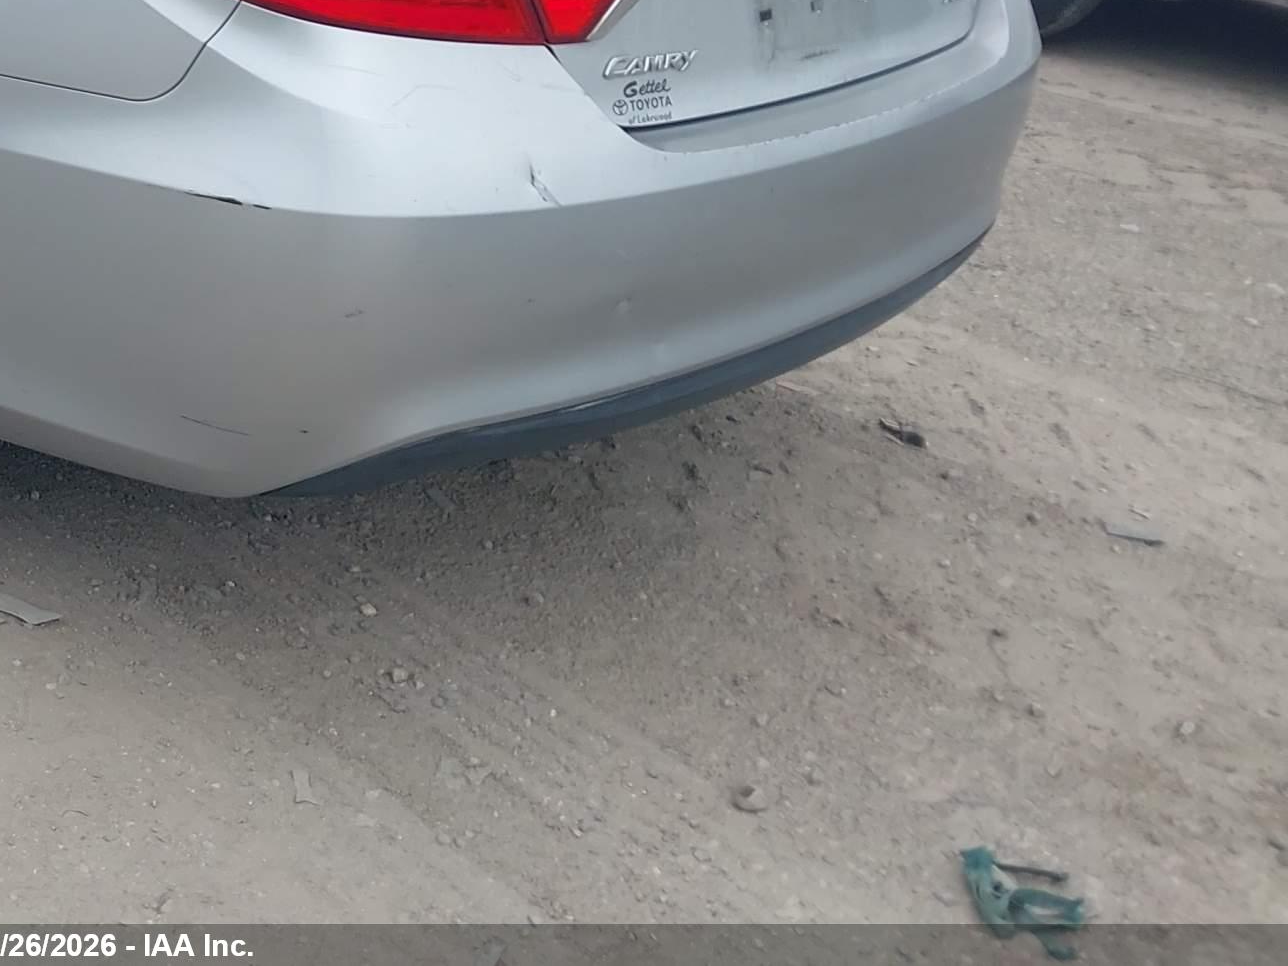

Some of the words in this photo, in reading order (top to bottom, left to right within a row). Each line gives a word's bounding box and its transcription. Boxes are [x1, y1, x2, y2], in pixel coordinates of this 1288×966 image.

[602, 49, 698, 79] CAMRY
[623, 78, 672, 98] Gettel
[630, 95, 673, 112] TOYOTA
